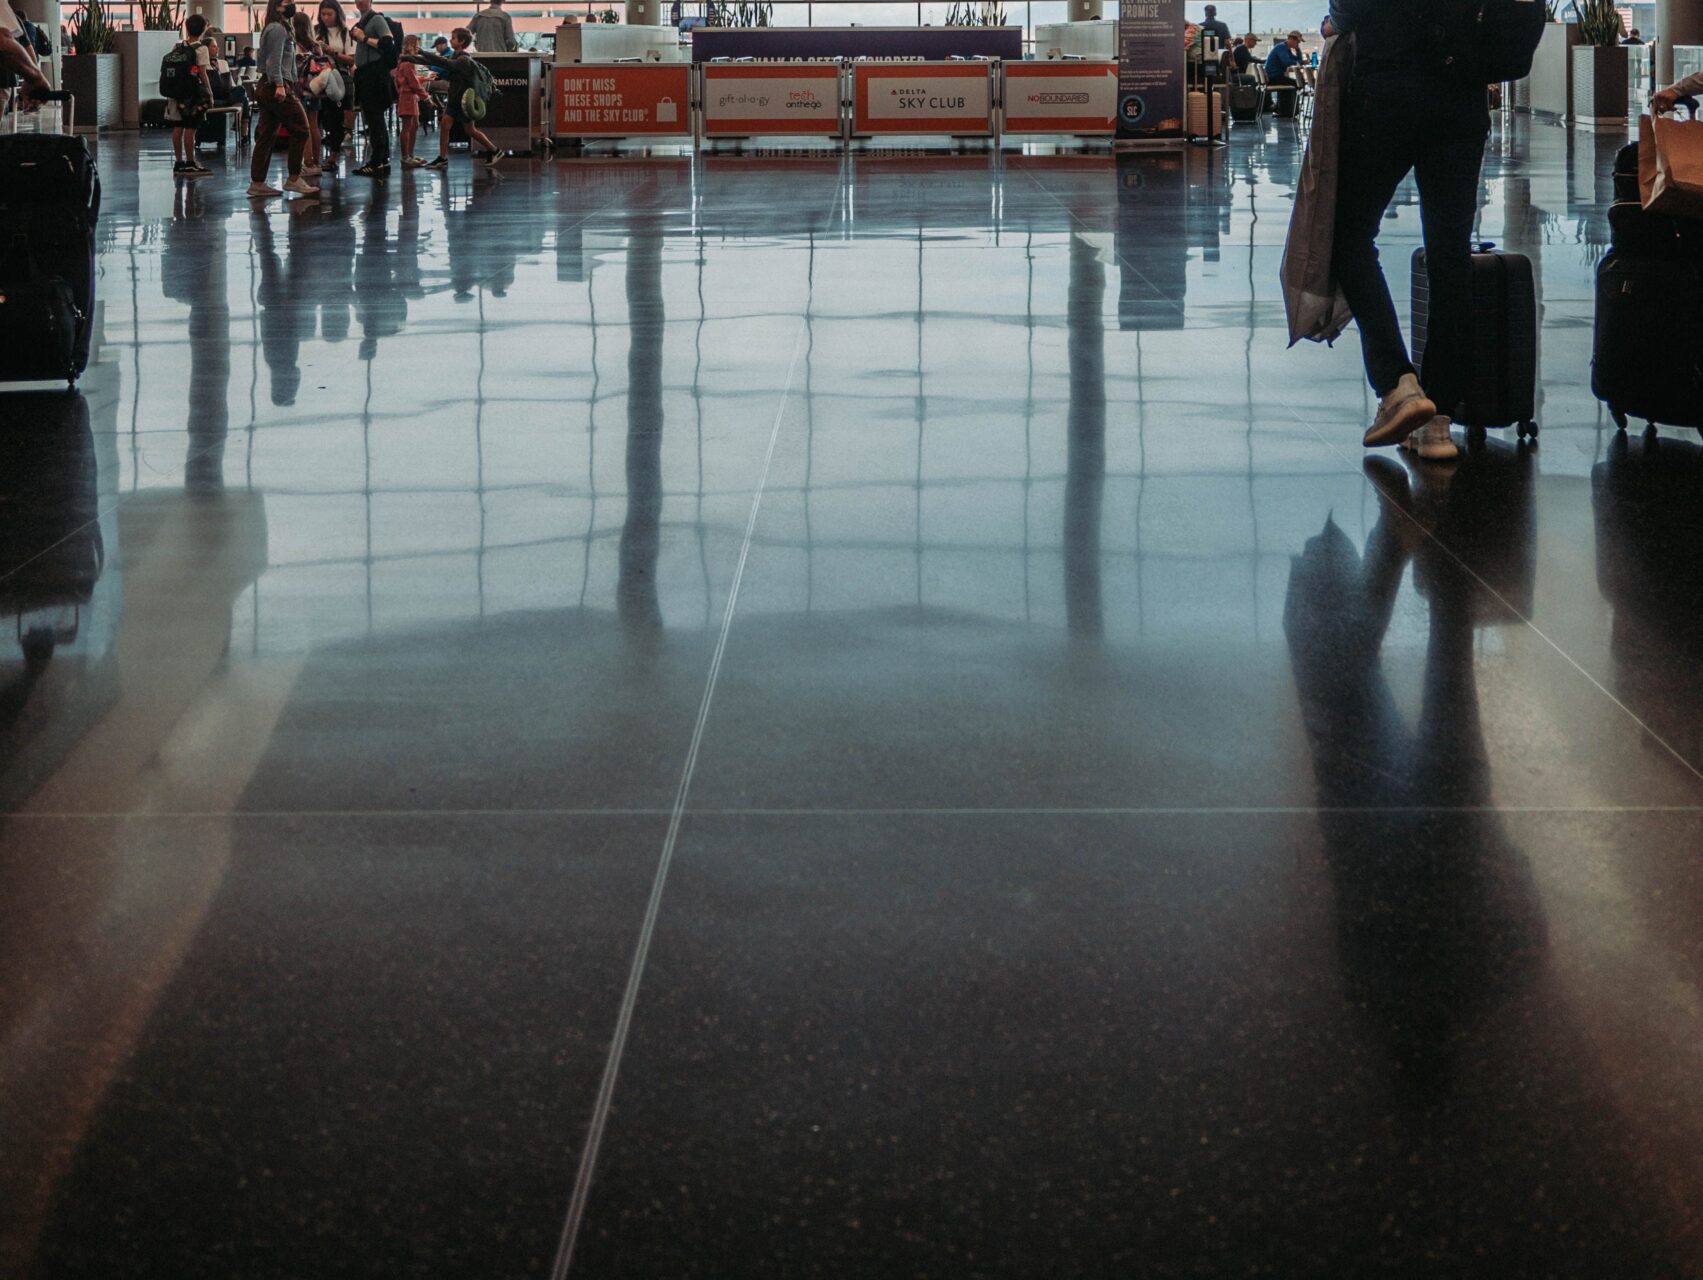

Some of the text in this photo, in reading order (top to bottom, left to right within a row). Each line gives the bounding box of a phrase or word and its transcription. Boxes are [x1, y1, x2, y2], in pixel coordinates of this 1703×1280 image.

[1121, 4, 1159, 18] PROMISE
[564, 78, 616, 92] DON'T MISS
[564, 94, 623, 107] THESE SHOPS
[788, 89, 815, 101] tech
[899, 97, 965, 109] SKY CLUB
[564, 109, 582, 122] AND
[584, 109, 601, 122] THE
[603, 109, 620, 122] SKY
